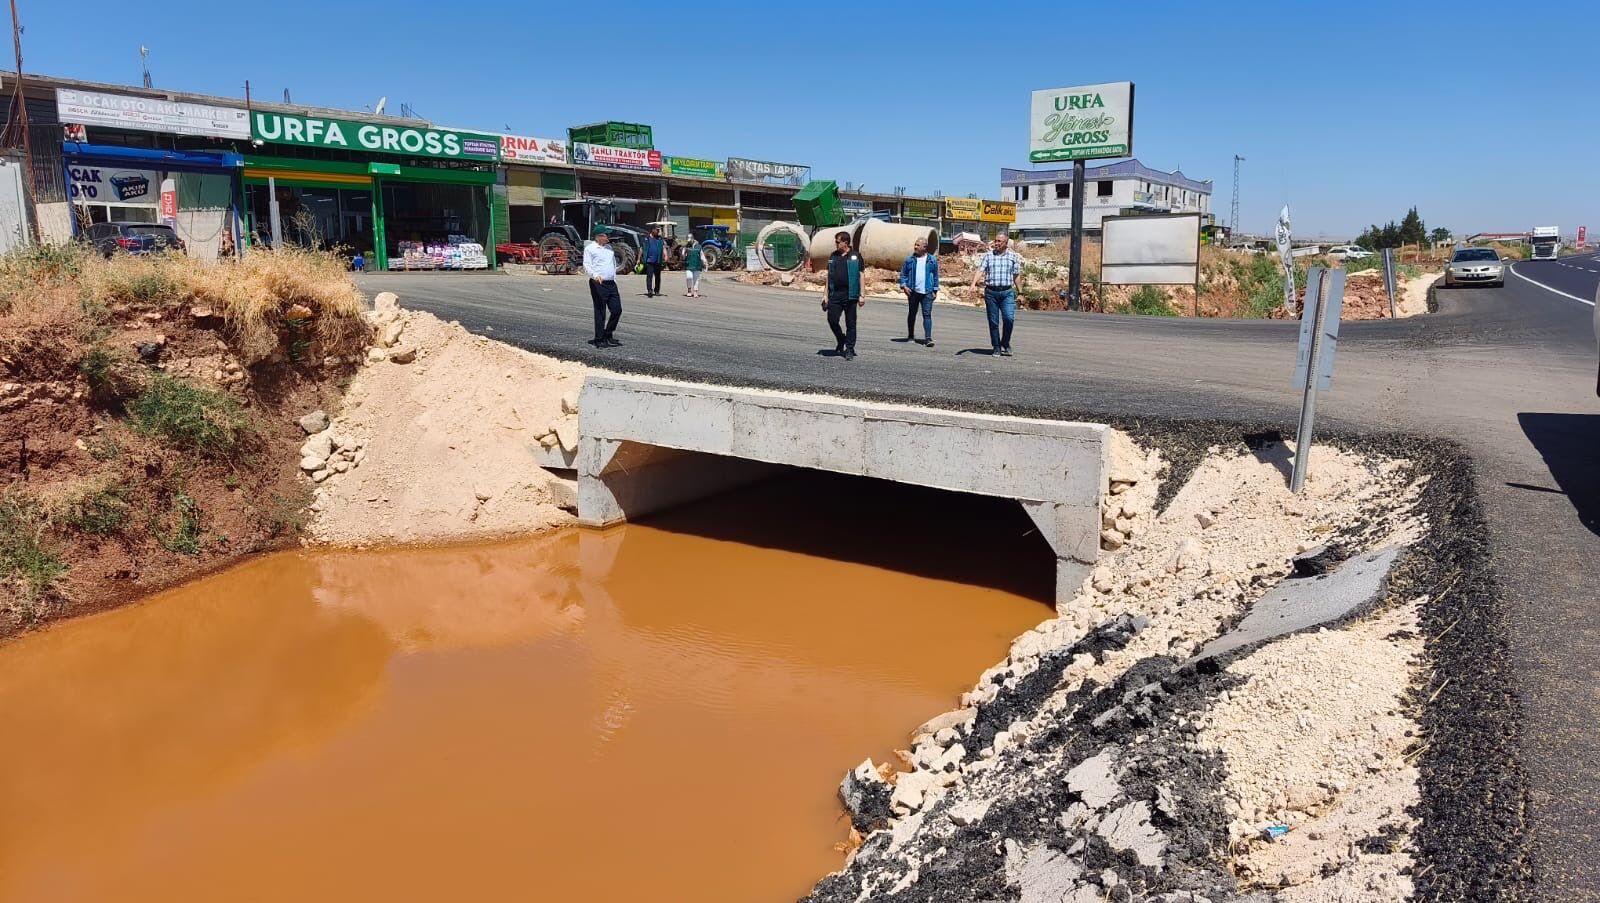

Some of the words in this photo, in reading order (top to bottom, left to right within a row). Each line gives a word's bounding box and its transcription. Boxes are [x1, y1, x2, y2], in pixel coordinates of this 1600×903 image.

[83, 95, 118, 109] OCAK
[120, 100, 146, 112] OTO
[183, 106, 229, 120] MARKET
[1054, 92, 1104, 111] URFA
[256, 114, 348, 146] URFA
[358, 125, 461, 155] GROSS
[1062, 130, 1109, 146] GROSS
